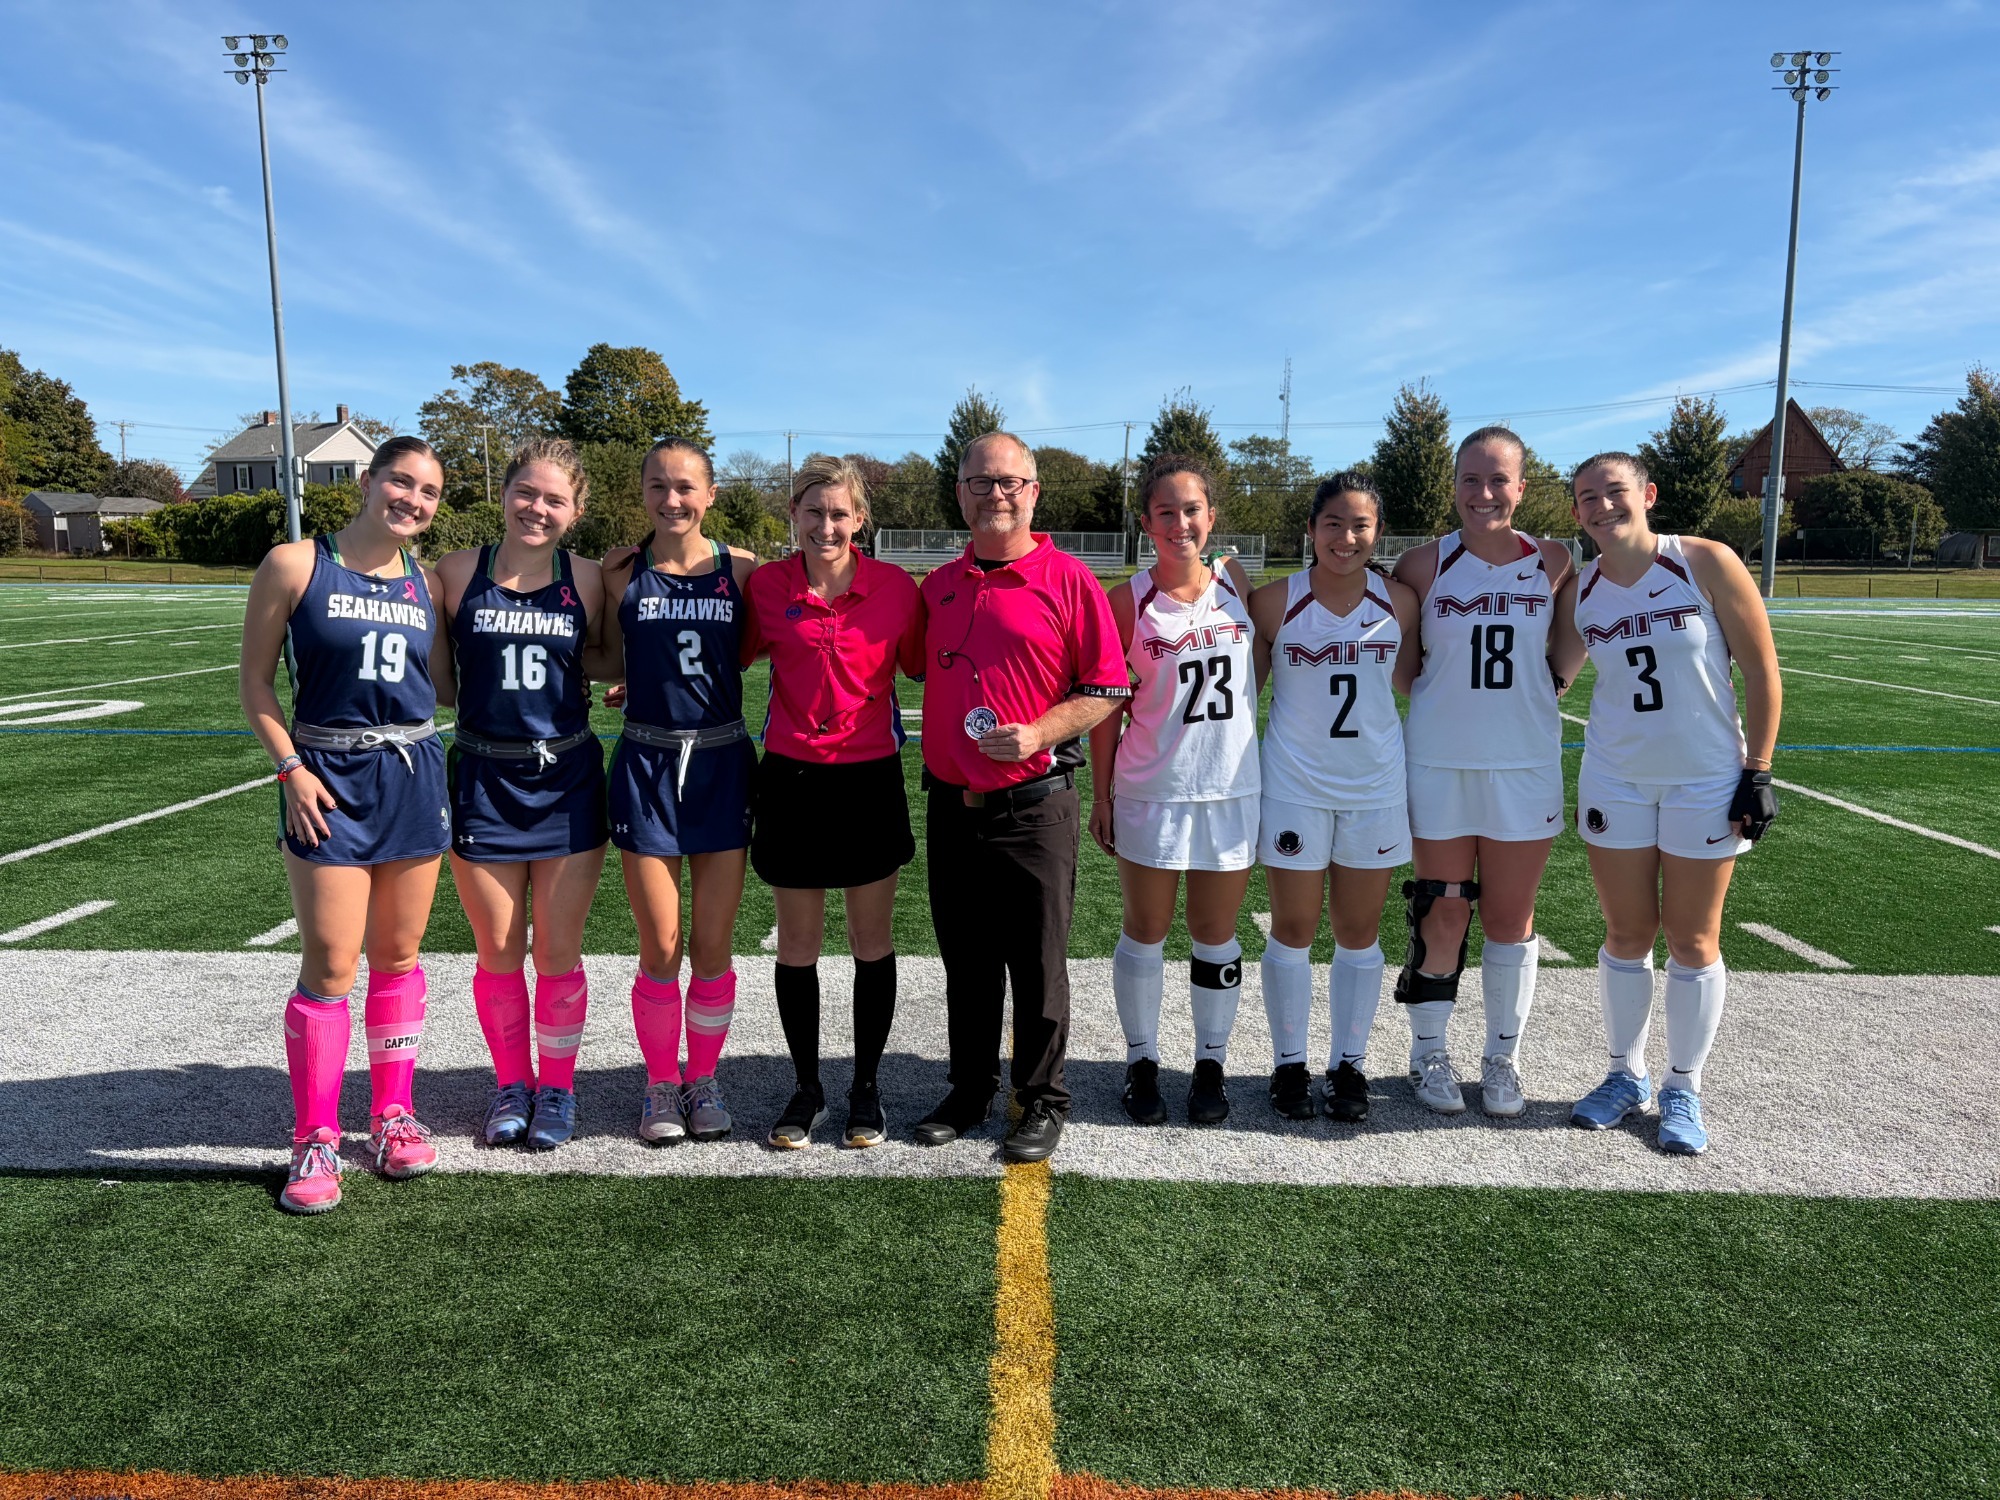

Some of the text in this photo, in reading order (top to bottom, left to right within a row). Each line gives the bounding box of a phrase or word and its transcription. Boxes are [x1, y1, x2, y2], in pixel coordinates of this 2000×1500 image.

[327, 593, 427, 631] SEAHAWKS
[473, 609, 575, 637] SEAHAWKS
[638, 597, 734, 623] SEAHAWKS
[1434, 592, 1548, 618] MIT
[1142, 621, 1249, 660] MIT
[1583, 605, 1701, 648] MIT
[358, 630, 408, 683] 19
[502, 644, 548, 691] 16
[677, 629, 704, 676] 2
[1283, 640, 1398, 667] MIT
[1470, 624, 1515, 690] 18
[1084, 685, 1102, 696] USA
[1178, 654, 1234, 726] 23
[1625, 645, 1664, 713] 3
[1329, 673, 1359, 739] 2
[1219, 963, 1238, 988] C
